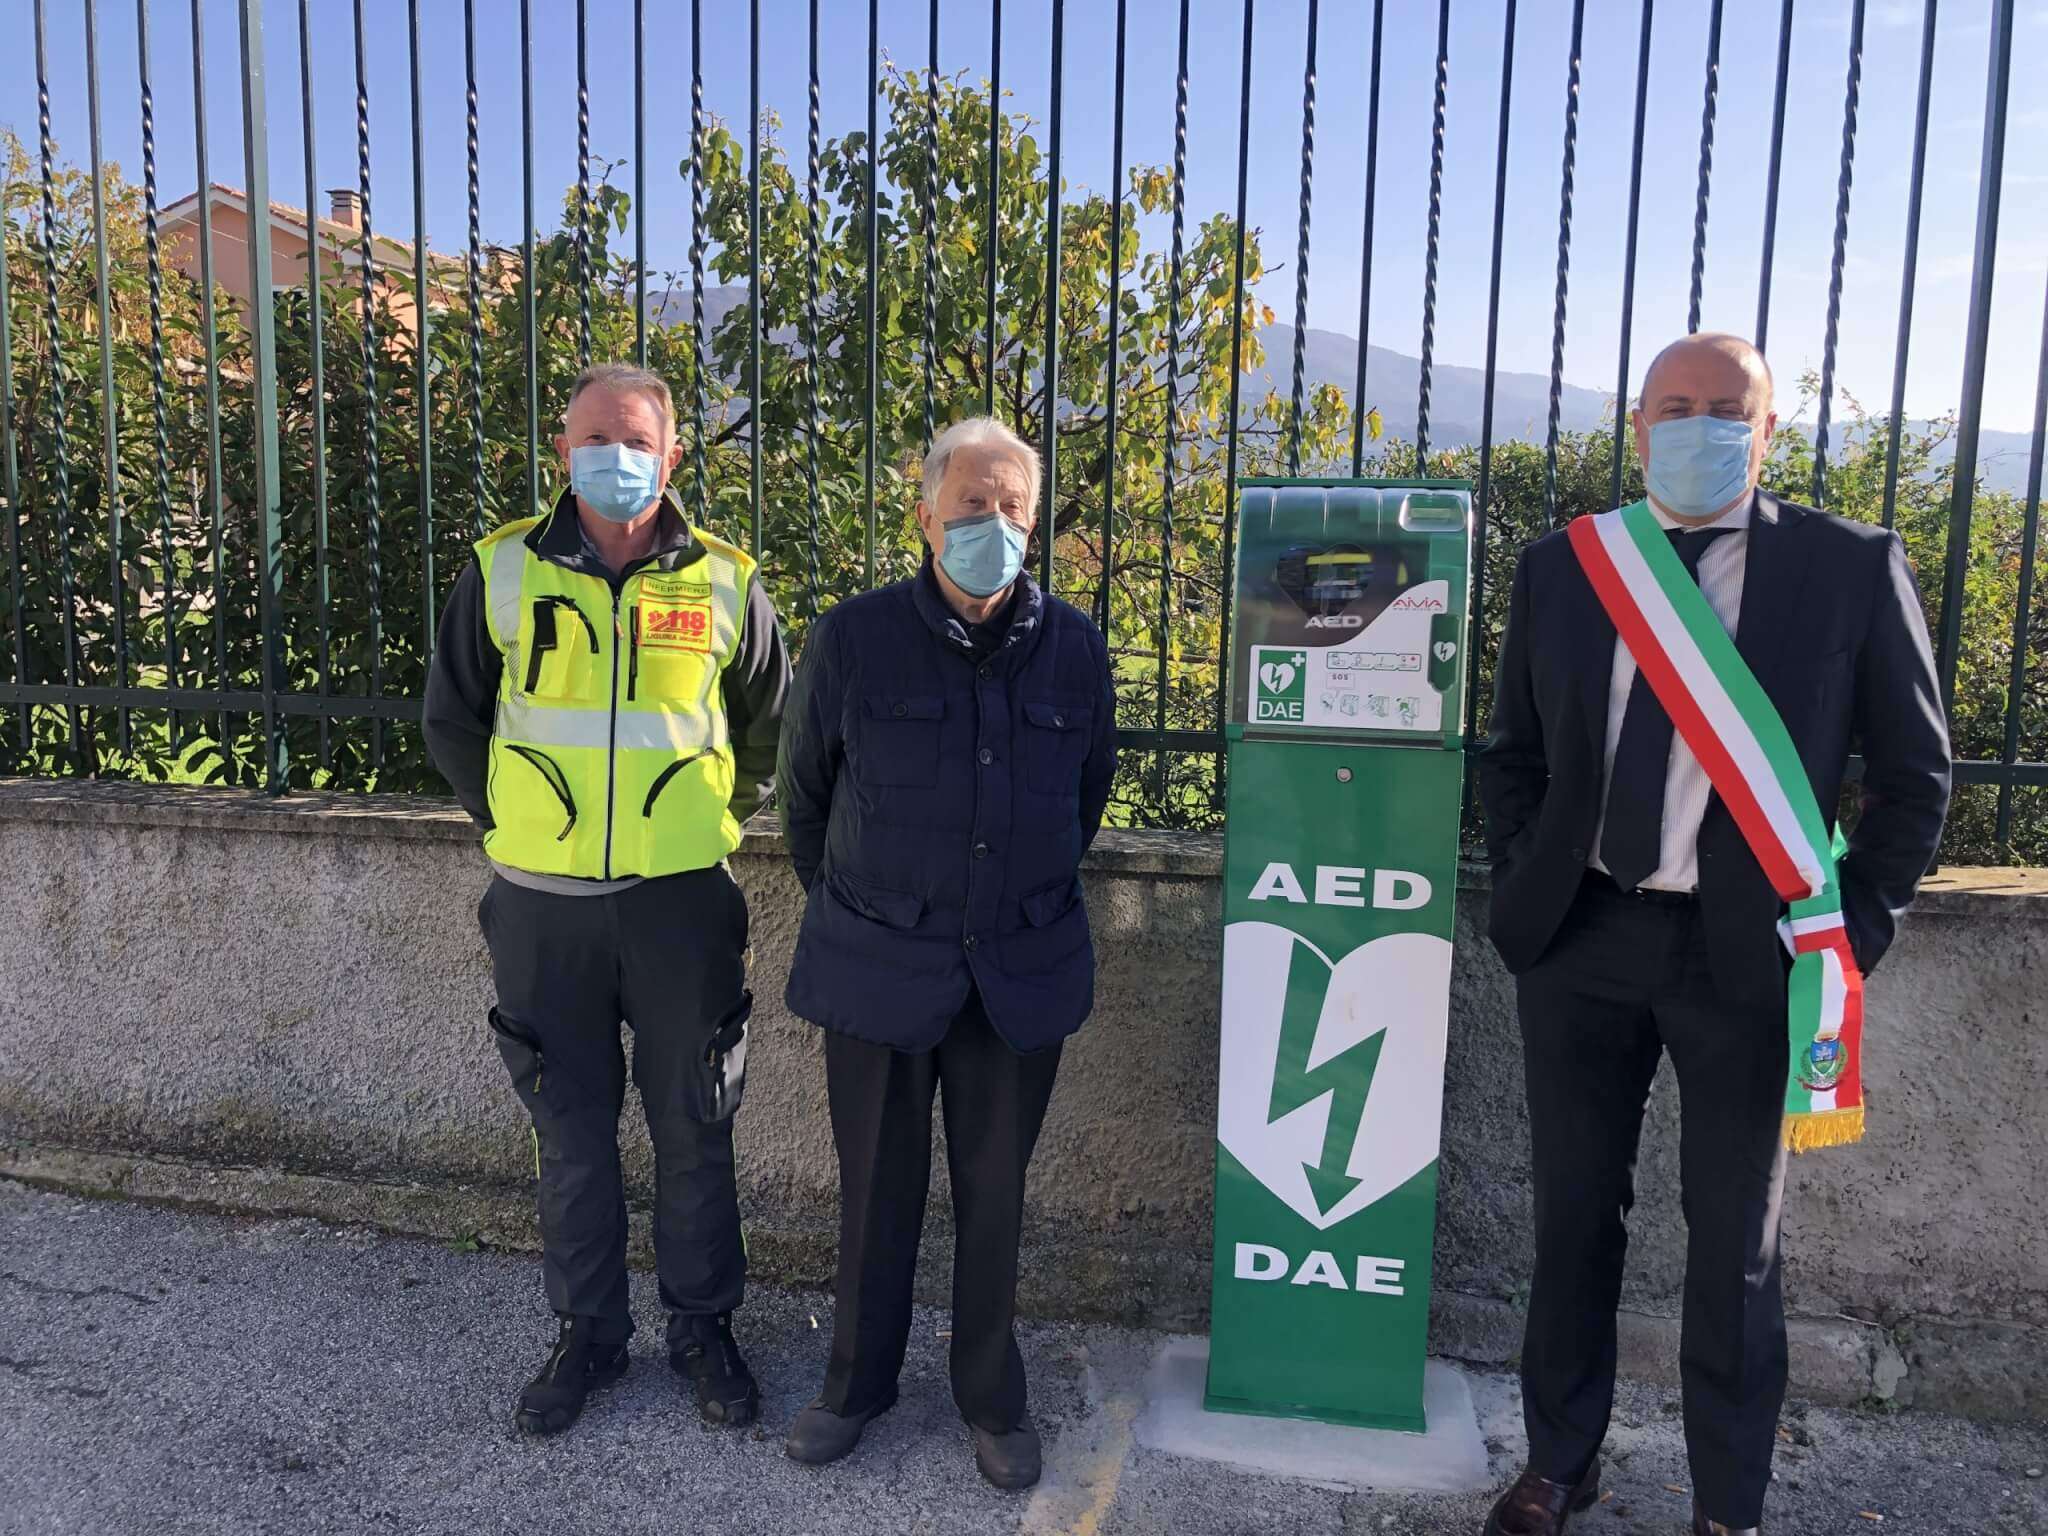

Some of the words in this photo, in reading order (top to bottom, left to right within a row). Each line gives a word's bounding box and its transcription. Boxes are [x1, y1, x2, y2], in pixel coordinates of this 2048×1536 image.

[666, 610, 706, 630] 118
[1304, 615, 1363, 629] AED
[1332, 673, 1349, 681] SOS
[1258, 700, 1302, 719] DAE
[1247, 862, 1433, 910] AED
[1234, 1242, 1405, 1296] DAE
